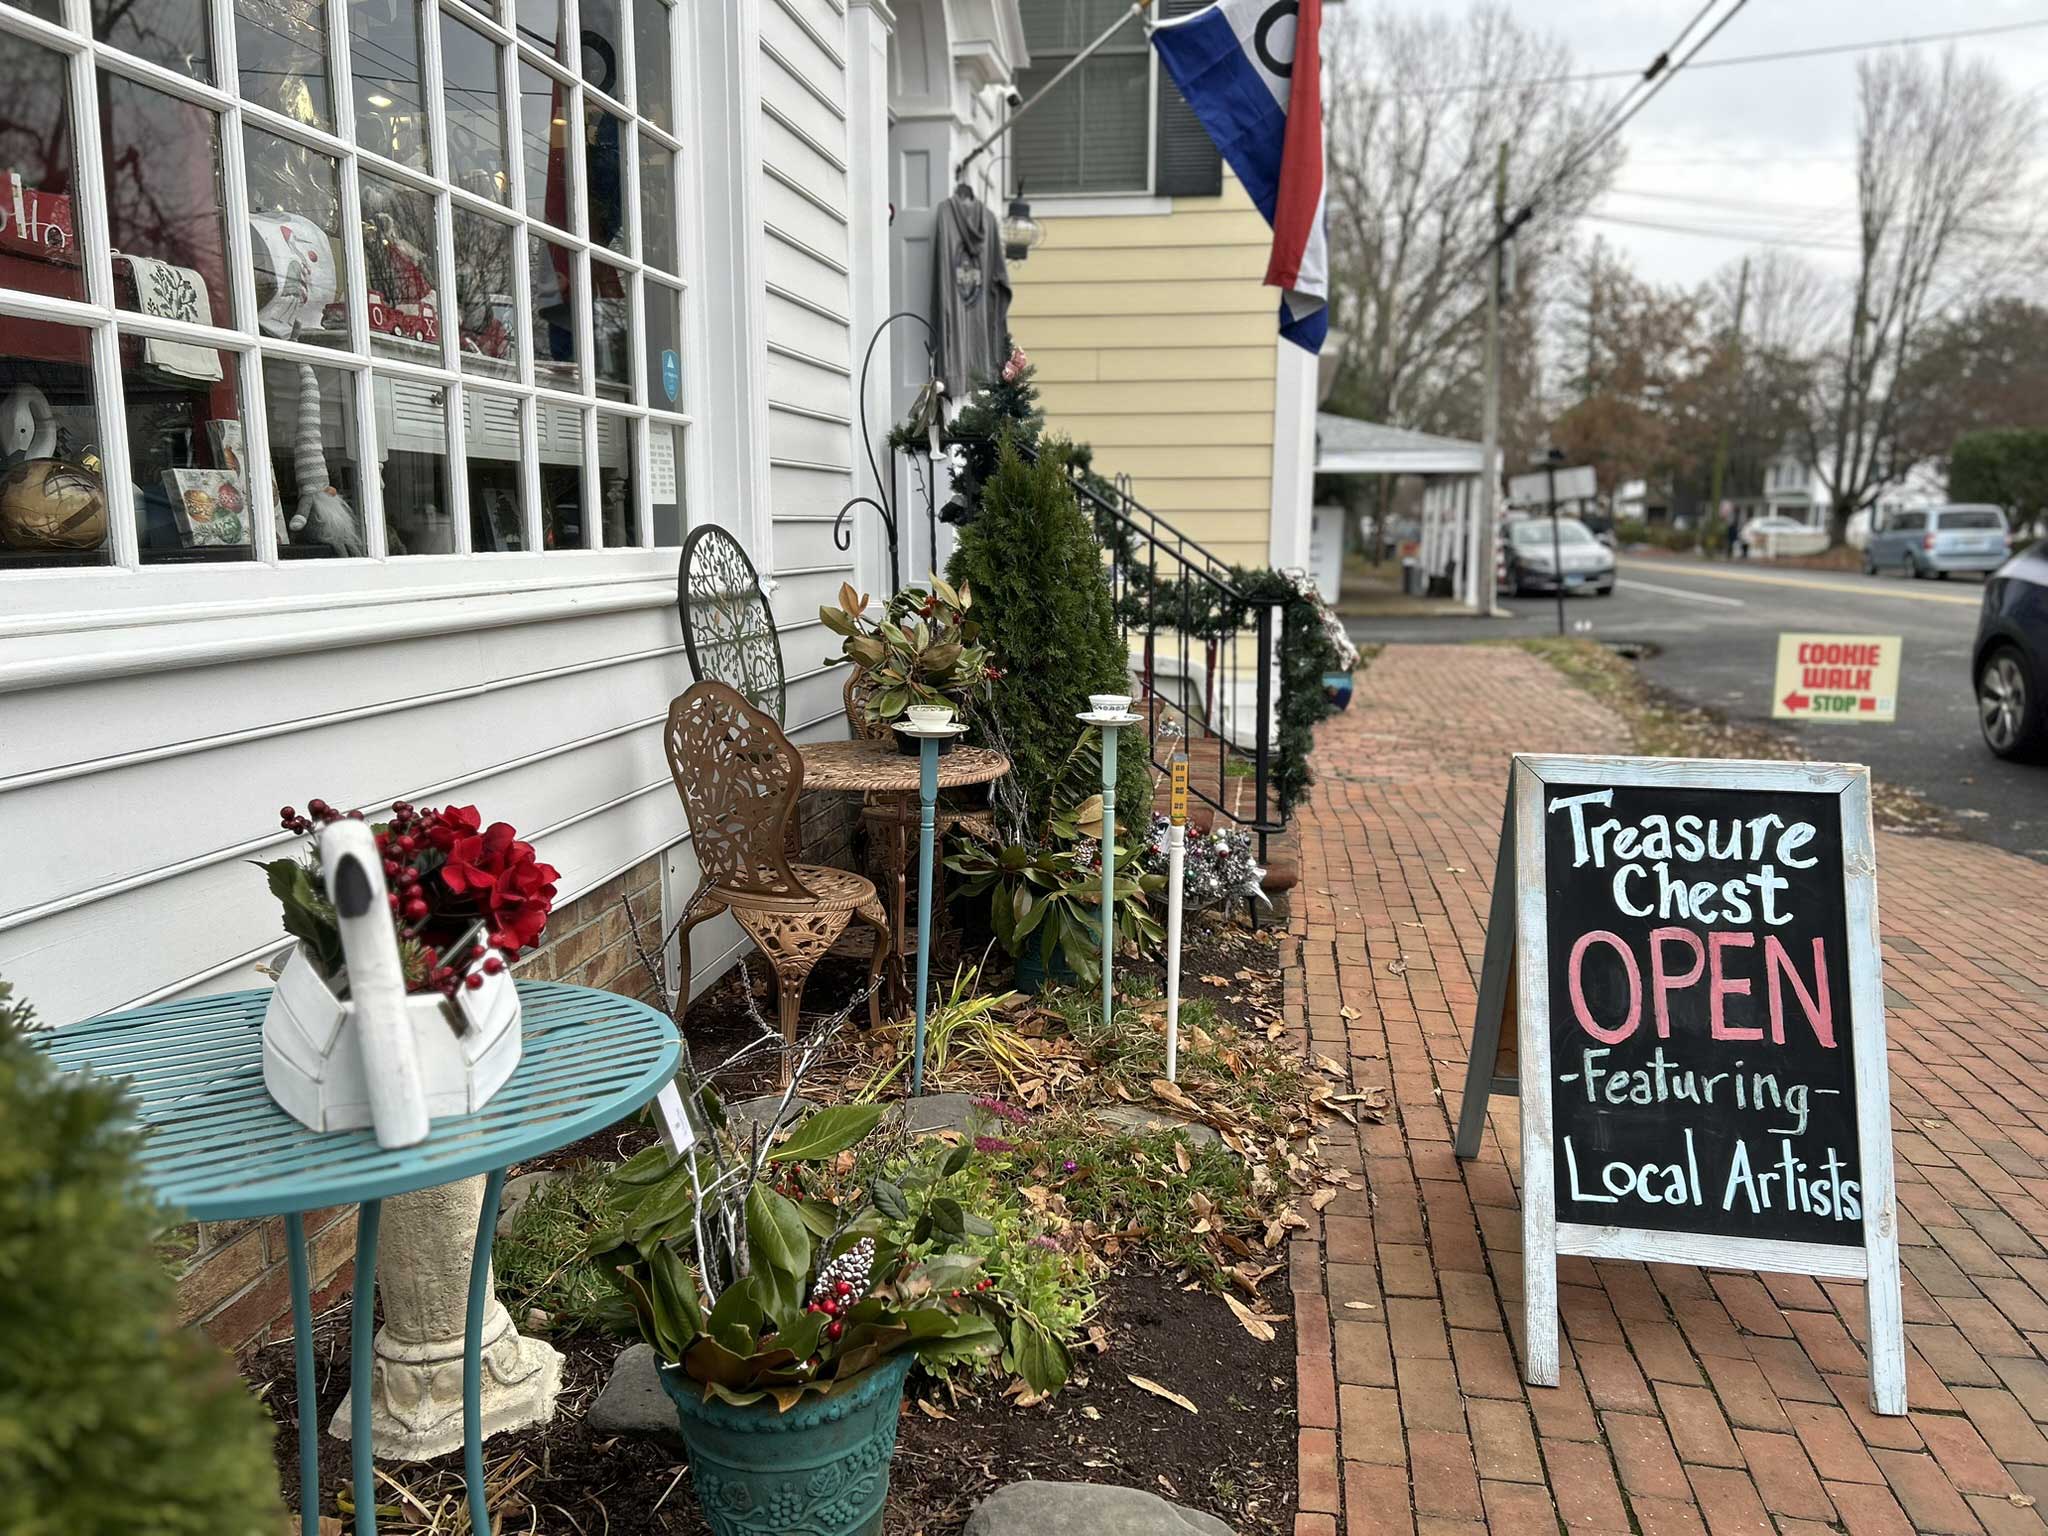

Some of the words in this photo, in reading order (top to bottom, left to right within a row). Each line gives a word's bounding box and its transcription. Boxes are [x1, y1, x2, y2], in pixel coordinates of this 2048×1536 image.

[1798, 643, 1881, 667] COOKIE
[1802, 668, 1872, 691] WALK
[1812, 694, 1857, 713] STOP
[1548, 788, 1819, 868] Treasure
[1613, 862, 1794, 926] Chest
[1568, 926, 1838, 1048] OPEN
[1564, 1128, 1703, 1206] Local
[1722, 1138, 1862, 1222] Artists
